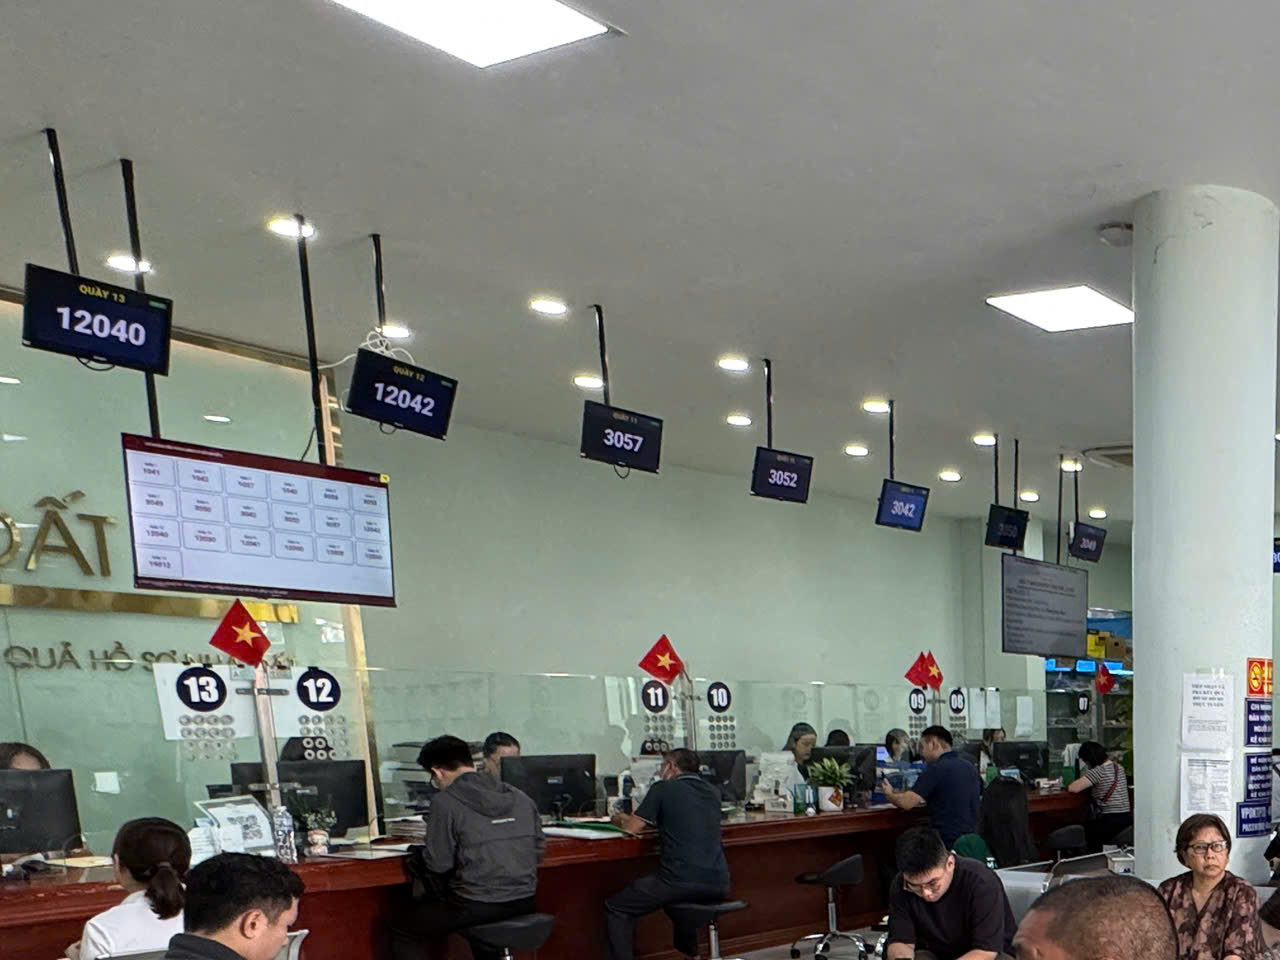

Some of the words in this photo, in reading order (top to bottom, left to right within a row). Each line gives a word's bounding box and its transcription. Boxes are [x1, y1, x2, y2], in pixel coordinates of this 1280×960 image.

[112, 292, 126, 303] 13
[56, 306, 146, 346] 12040
[374, 383, 435, 417] 12042
[603, 428, 643, 452] 3057
[768, 469, 798, 487] 3052
[891, 500, 916, 517] 3042
[0, 490, 119, 577] ẤT
[3, 640, 82, 671] QUẢ
[183, 676, 219, 703] 13
[302, 677, 334, 703] 12
[647, 687, 664, 706] 11
[710, 688, 728, 707] 10
[911, 693, 925, 710] 09
[951, 692, 964, 709] 08
[1078, 697, 1088, 711] 07
